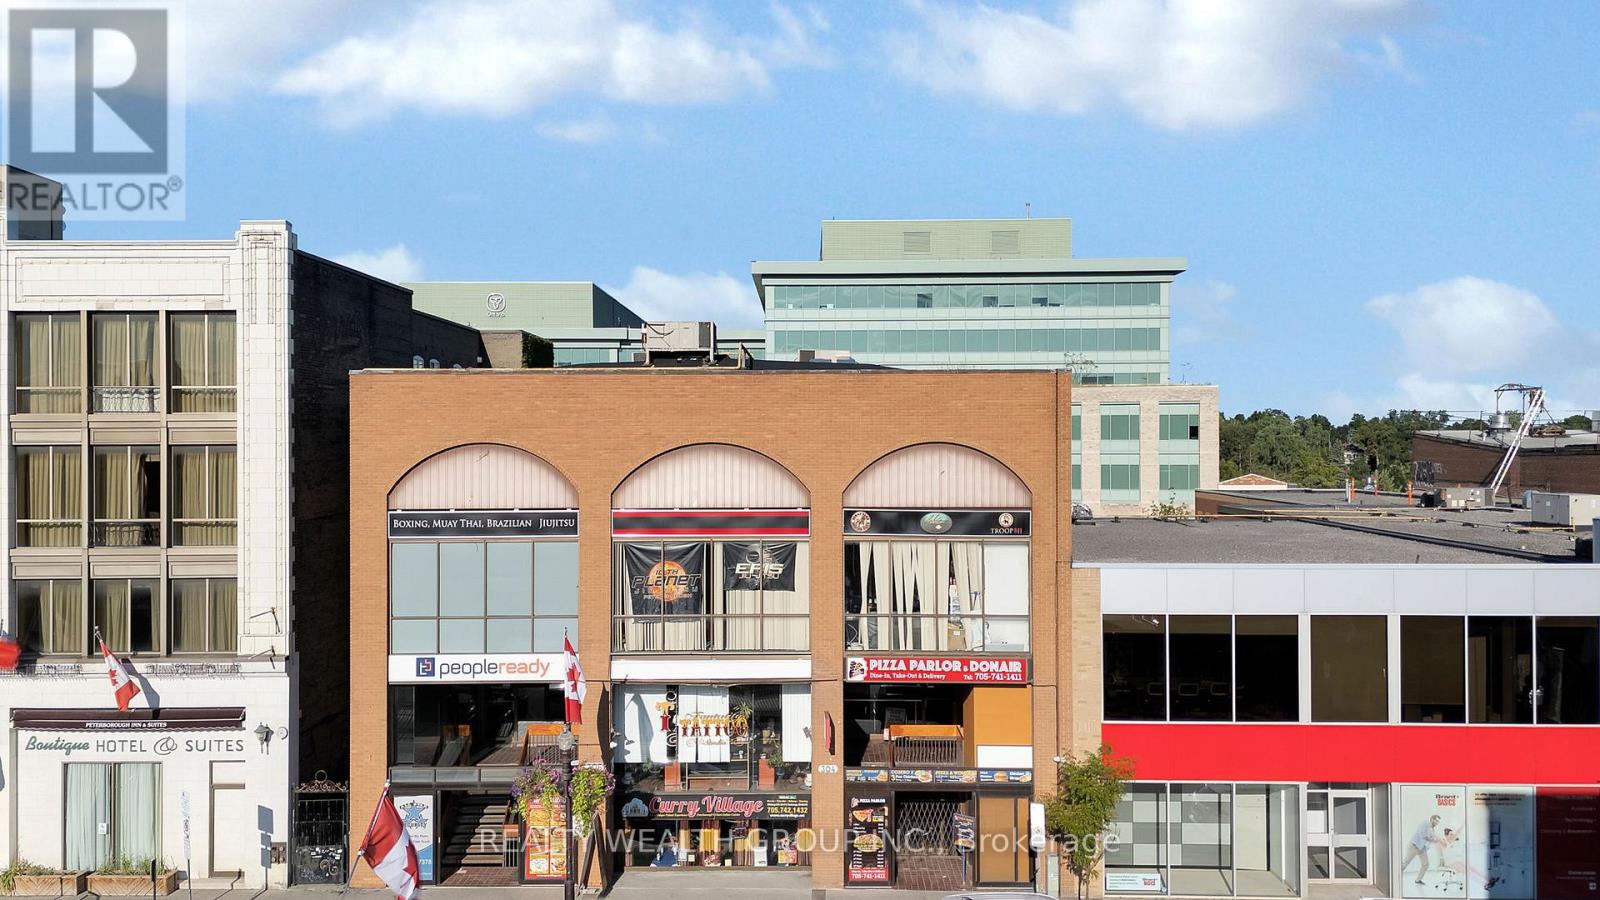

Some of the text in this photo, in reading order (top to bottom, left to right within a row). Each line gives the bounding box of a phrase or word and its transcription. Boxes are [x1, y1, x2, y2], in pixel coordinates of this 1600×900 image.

[393, 519, 575, 529] BOXING, MUAY THAI, BRAZILIAN JIUJITSU
[439, 658, 550, 679] peopleready
[869, 659, 907, 671] PIZZA
[909, 660, 962, 672] PARLOR
[969, 660, 1022, 673] DONAIR
[923, 673, 946, 681] Delivery
[25, 735, 90, 756] Boutique
[96, 739, 147, 752] HOTEL
[185, 739, 244, 752] SUITES
[649, 795, 764, 818] Curry Village
[767, 806, 808, 814] 705.742.1432
